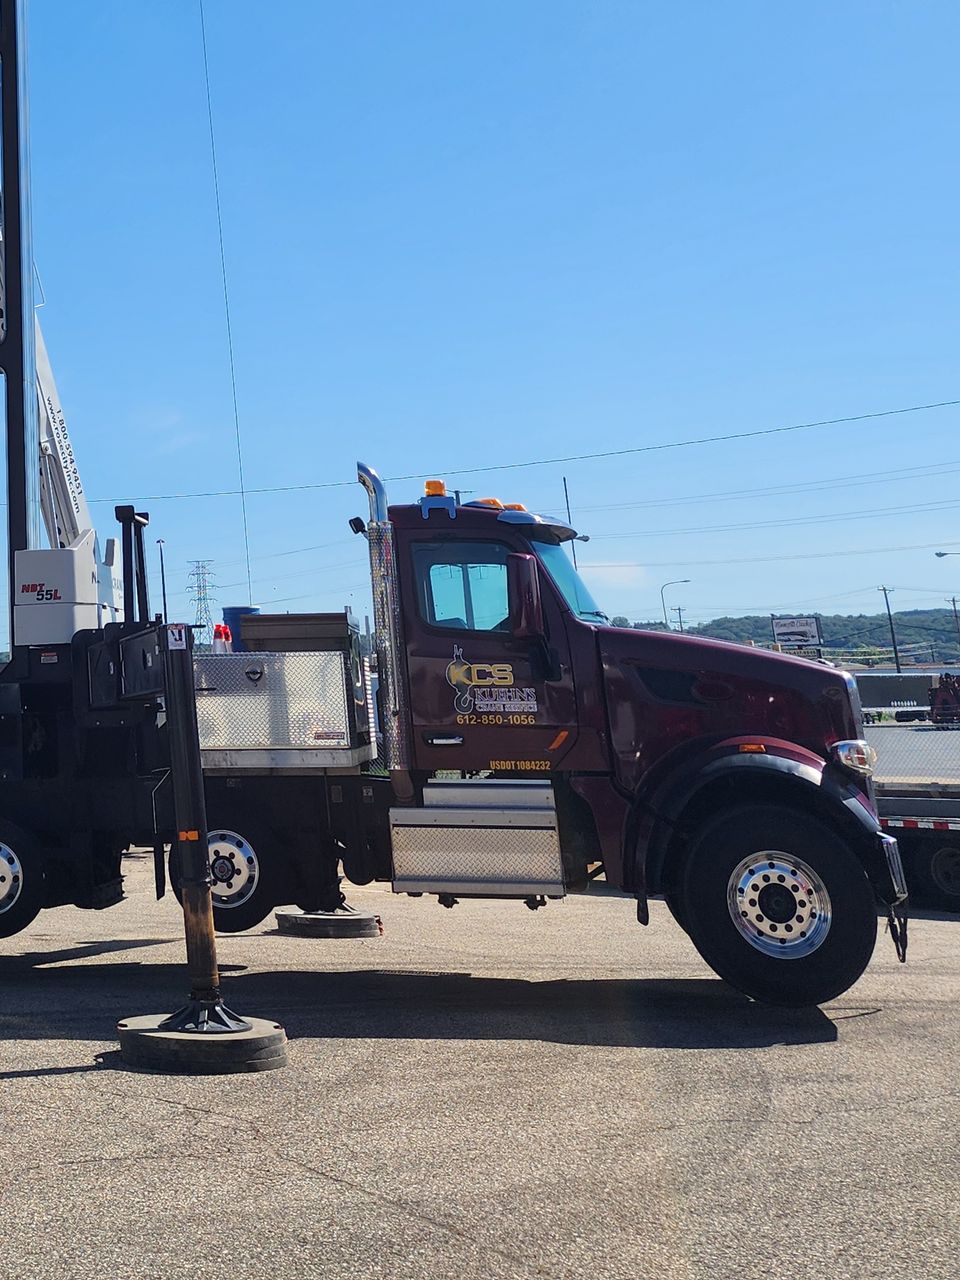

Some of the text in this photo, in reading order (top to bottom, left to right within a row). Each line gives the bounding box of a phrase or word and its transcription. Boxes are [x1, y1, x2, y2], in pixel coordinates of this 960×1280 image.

[46, 396, 80, 514] www.rosecityinc.com
[21, 583, 46, 593] NBT
[36, 589, 62, 601] 55L
[449, 664, 514, 686] KCS
[456, 715, 536, 725] 612-850-1056
